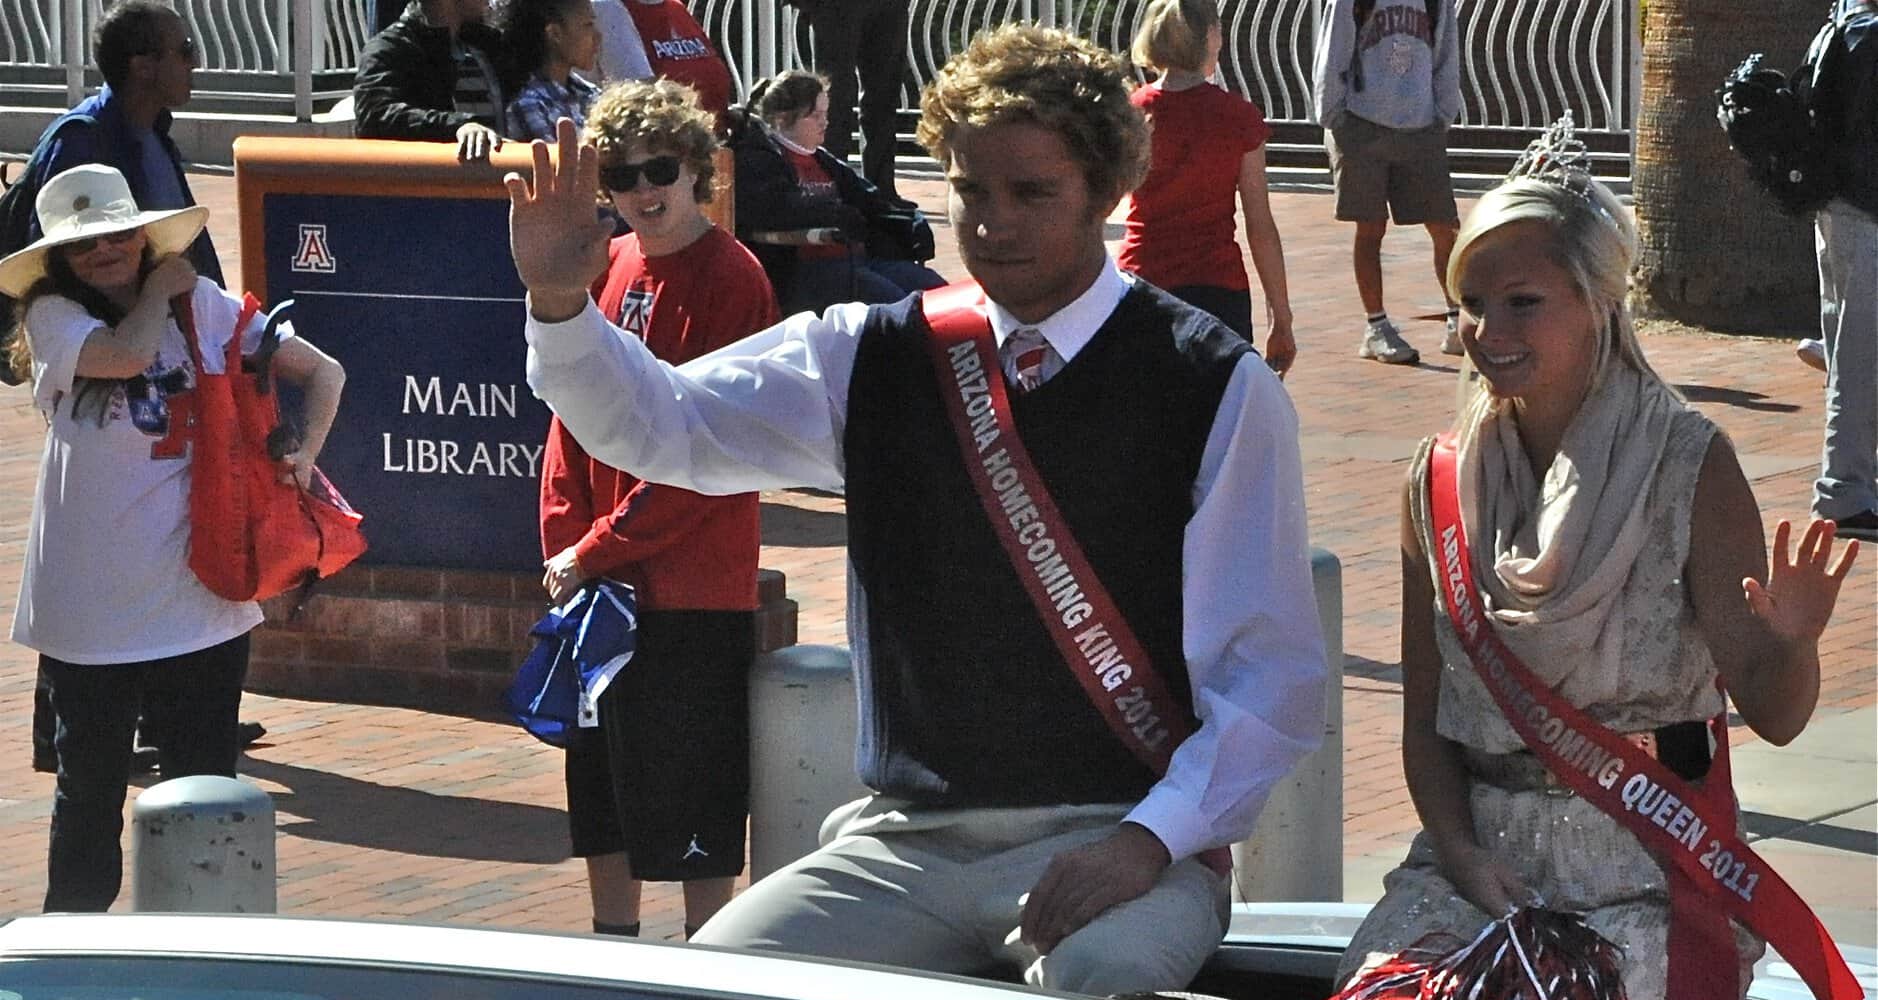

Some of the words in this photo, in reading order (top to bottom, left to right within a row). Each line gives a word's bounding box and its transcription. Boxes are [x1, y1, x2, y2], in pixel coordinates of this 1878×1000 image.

[291, 224, 336, 273] A
[948, 339, 1001, 454] ARIZONA
[982, 446, 1094, 630] HOMECOMING
[1073, 622, 1132, 693] KING
[1114, 685, 1170, 753] 2011
[1441, 524, 1480, 640] ARIZONA
[1476, 632, 1626, 792] HOMECOMING
[1621, 772, 1708, 853] QUEEN
[1699, 838, 1762, 902] 2011
